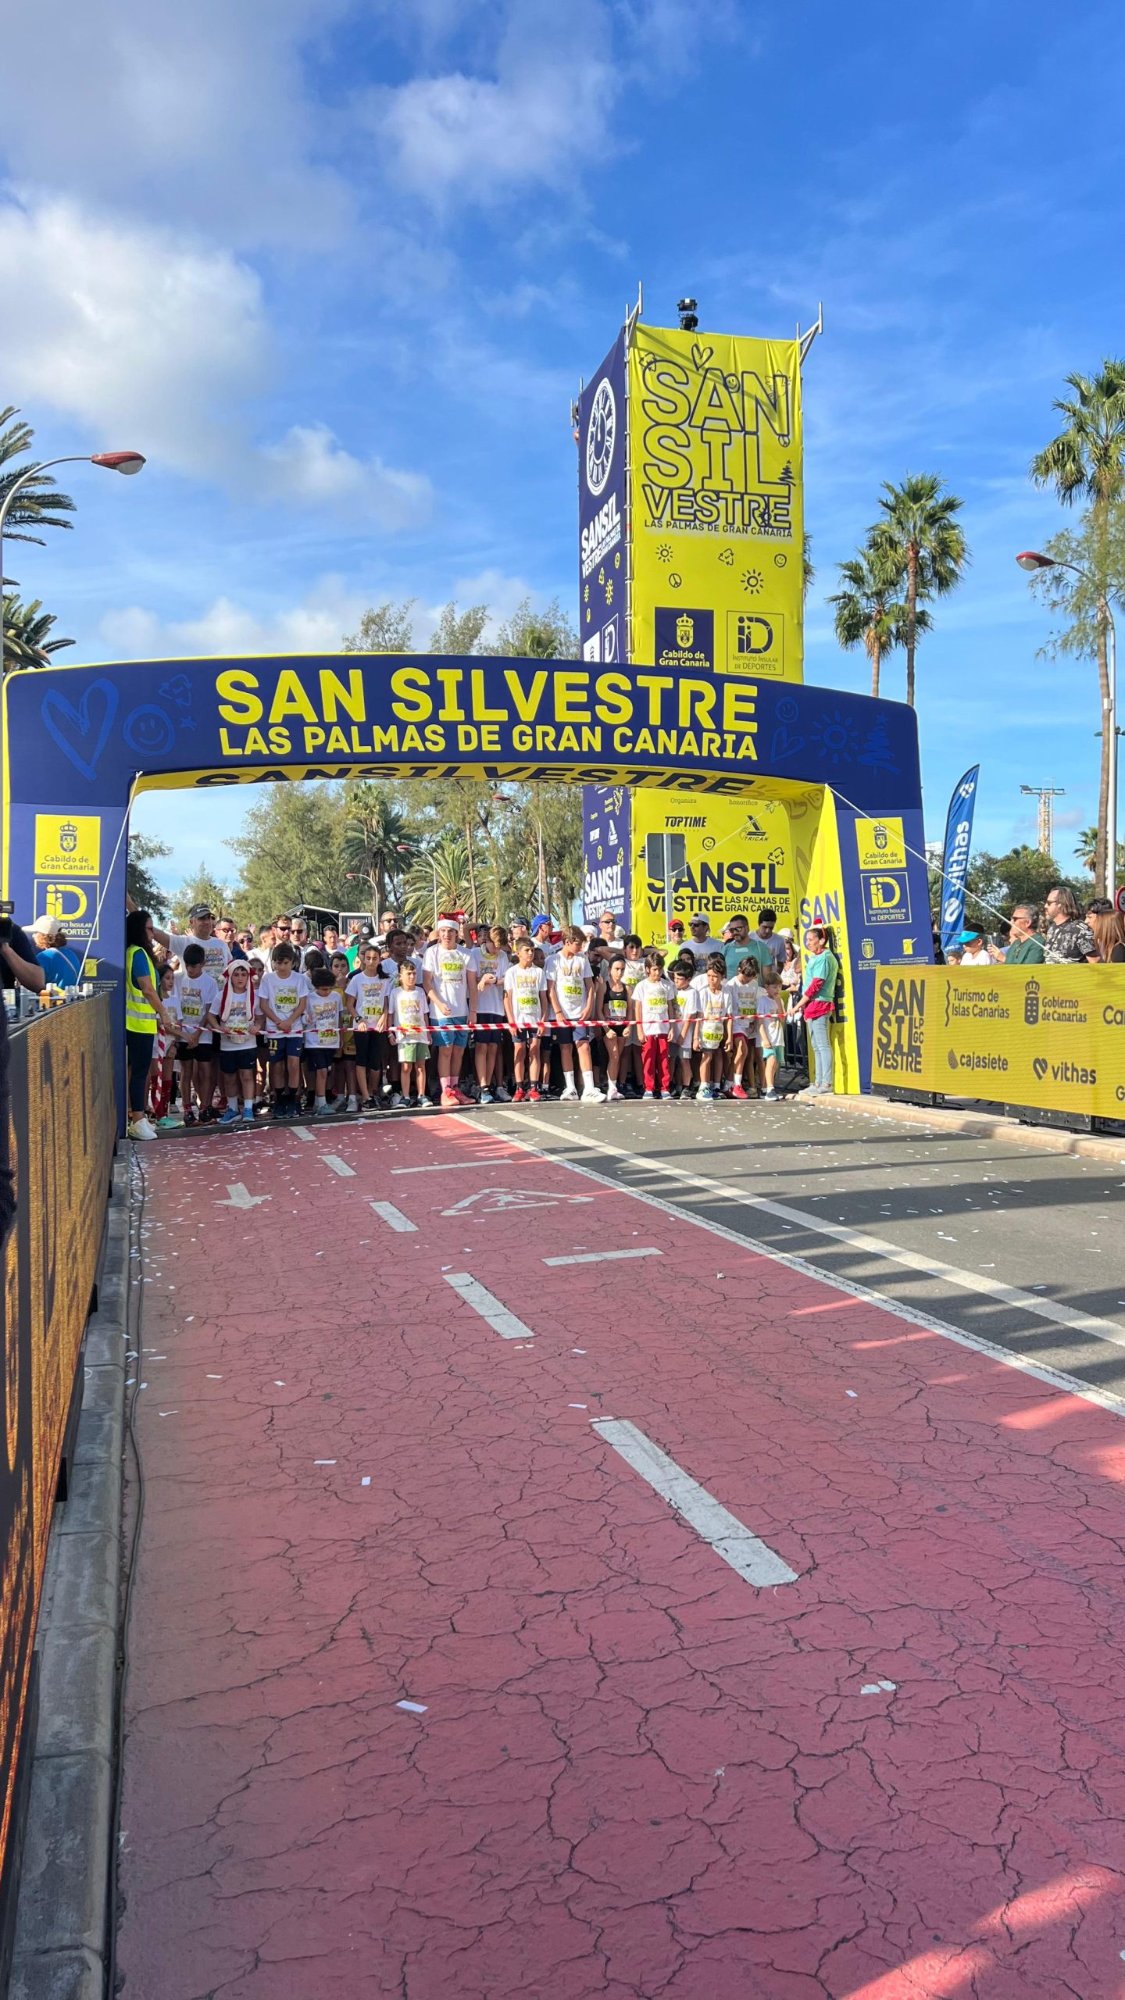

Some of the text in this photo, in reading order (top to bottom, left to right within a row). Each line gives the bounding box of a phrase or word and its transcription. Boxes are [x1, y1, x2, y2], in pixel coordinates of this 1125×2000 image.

[642, 359, 789, 437] SAN
[642, 423, 790, 496] SIL
[641, 484, 792, 529] VESTRE
[581, 492, 621, 561] SANSIL
[644, 519, 793, 538] LAS PALMAS DE GRAN CANARIA
[659, 658, 710, 667] Gran Canaria
[662, 650, 705, 659] Cabildo de
[742, 662, 777, 671] DEPORTES
[214, 667, 758, 734] SAN SILVESTRE
[219, 723, 759, 761] LAS PALMAS DE GRAN CANARIA
[665, 816, 707, 828] TOPTIME
[43, 855, 77, 863] Cabildo
[951, 821, 970, 892] vithas
[40, 862, 95, 871] Gran Canaria
[584, 865, 625, 904] SANSIL
[647, 896, 723, 913] VSTRE
[724, 896, 791, 905] LAS PALMAS DE
[724, 904, 790, 913] GRAN CANARIA
[799, 889, 840, 930] SAN
[61, 928, 90, 936] PORTES
[879, 978, 926, 1017] SAN
[953, 988, 999, 1003] Turismo de
[1042, 996, 1079, 1010] Gobierno
[951, 1002, 1010, 1019] Islas Canarias
[1042, 1010, 1087, 1023] de Canarias
[913, 1017, 925, 1030] LP
[268, 1039, 278, 1051] 11
[877, 1016, 921, 1057] SIL
[912, 1031, 925, 1045] GC
[876, 1048, 923, 1074] VESTRE
[959, 1051, 1009, 1072] cajasiete
[1052, 1062, 1097, 1085] vithas
